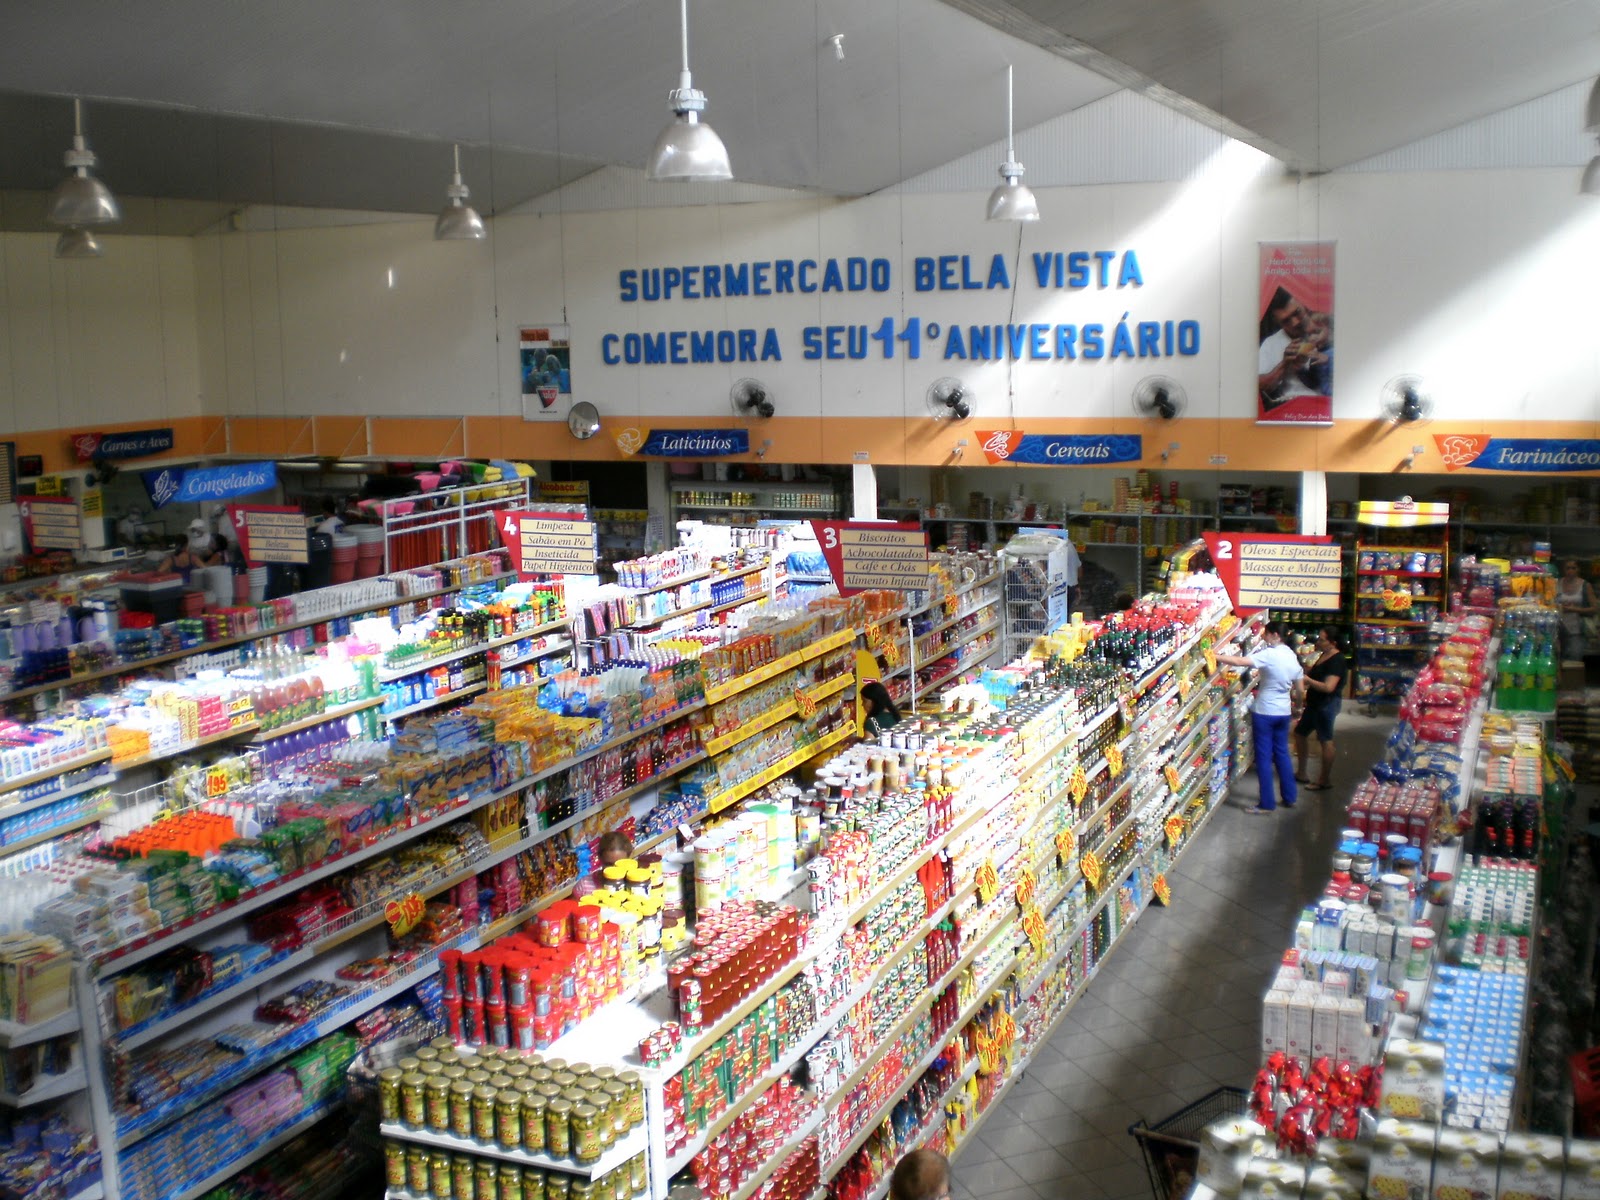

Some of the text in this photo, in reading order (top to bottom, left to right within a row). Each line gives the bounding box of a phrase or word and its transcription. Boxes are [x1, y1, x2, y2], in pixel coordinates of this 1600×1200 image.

[619, 250, 1144, 301] SUPERMERCADO BELA VISTA
[602, 328, 782, 365] COMEMORA
[803, 325, 868, 360] SEU
[944, 311, 1201, 360] ANIVERSÁRIO
[102, 440, 137, 452] Carnes
[149, 437, 170, 448] Aves
[661, 435, 732, 450] Laticínios
[1046, 443, 1110, 457] Cereais
[1498, 447, 1600, 465] Farináceo
[188, 471, 265, 496] Congelados
[21, 501, 29, 517] 6
[236, 510, 245, 527] 5
[503, 516, 517, 535] 4
[536, 521, 573, 531] Limpeza
[528, 535, 555, 545] Sabão
[574, 537, 586, 546] Pó
[823, 527, 837, 549] 3
[858, 533, 906, 543] Biscoitos
[535, 549, 579, 559] Inseticida
[845, 548, 924, 559] Achocolatados
[1217, 540, 1233, 559] 2
[1280, 546, 1338, 558] Especiais
[524, 561, 547, 571] Papel
[855, 561, 879, 573] Café
[890, 562, 917, 572] Chás
[1242, 562, 1284, 573] Massas
[1295, 563, 1340, 574] Molhos
[845, 576, 928, 588] Alimento Infantil
[1261, 577, 1319, 589] Refrescos
[1258, 594, 1319, 606] Dietéticos
